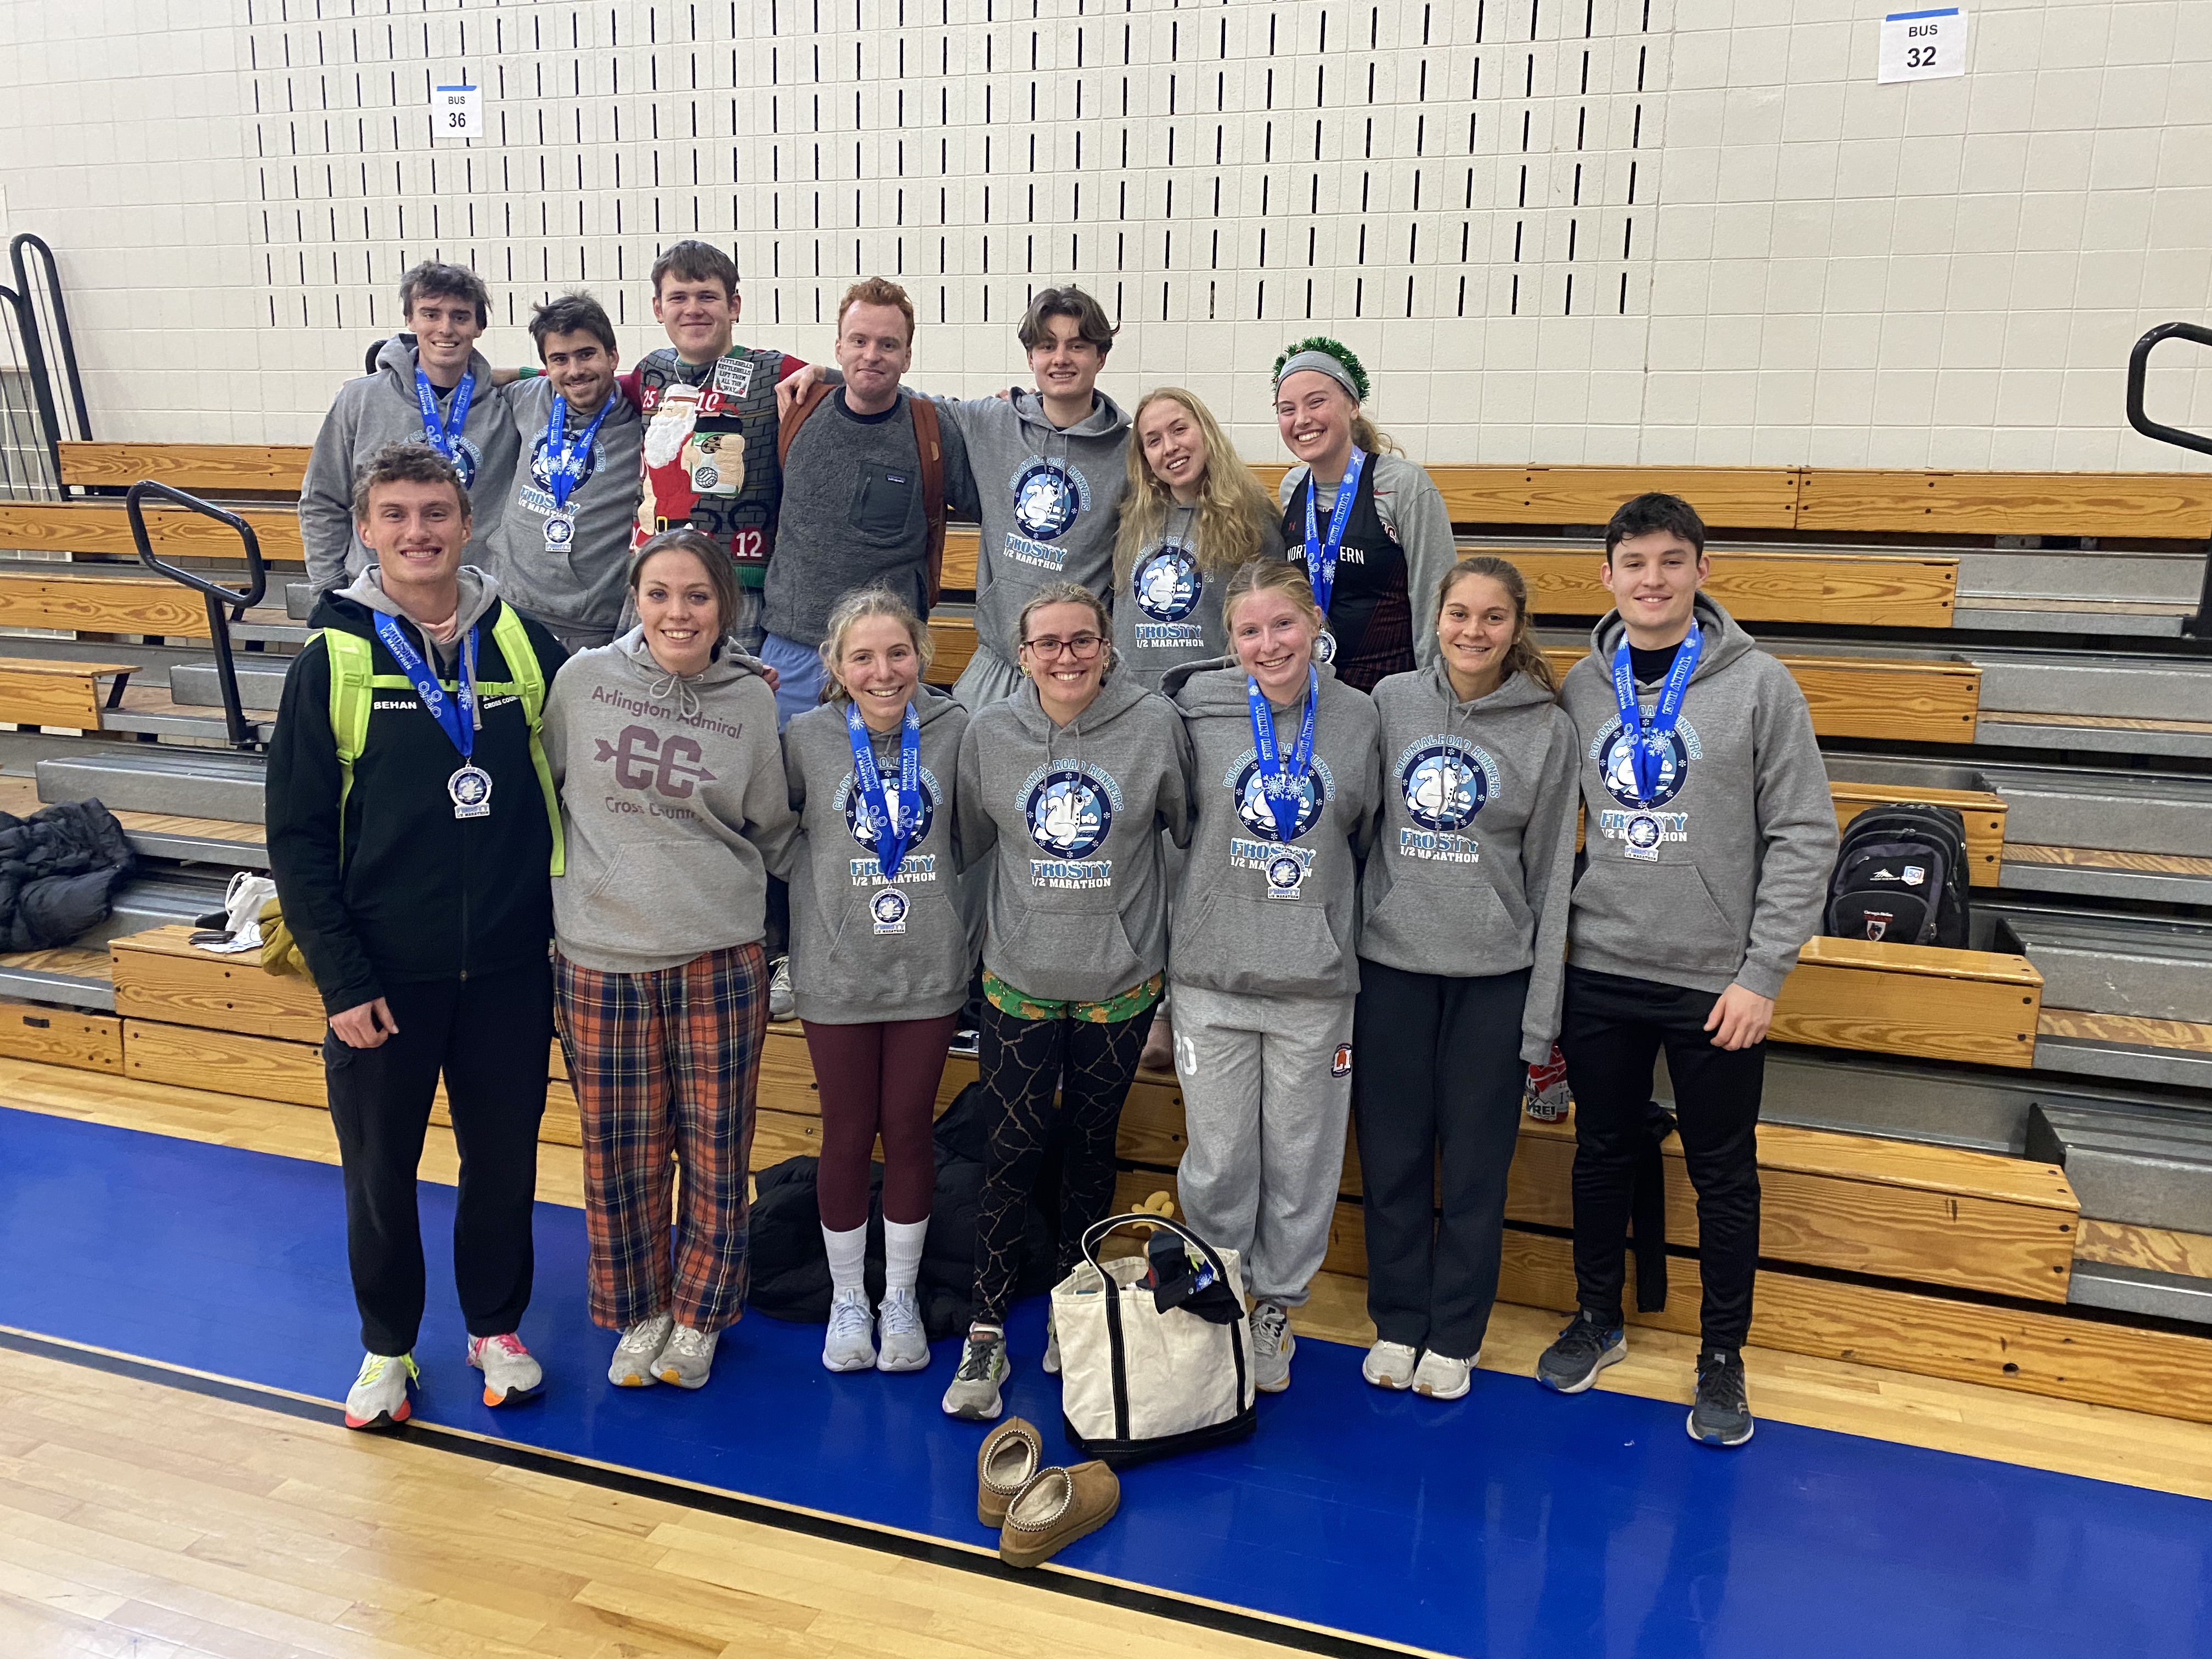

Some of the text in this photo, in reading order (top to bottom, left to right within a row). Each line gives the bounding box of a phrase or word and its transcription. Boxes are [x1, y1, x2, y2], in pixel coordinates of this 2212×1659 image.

[1909, 25, 1938, 37] BUS
[1907, 46, 1937, 67] 32
[448, 96, 465, 104] BUS
[449, 112, 466, 127] 36
[718, 364, 751, 375] KETTLEBELLS
[719, 359, 752, 369] KETTLEBELLS
[642, 390, 657, 409] 25
[696, 391, 720, 412] 10
[1008, 455, 1041, 490] COLONIAL
[1067, 465, 1091, 511] RUNNERS
[517, 497, 527, 507] 1/2
[520, 484, 581, 515] FROSY
[736, 531, 763, 557] 12
[1005, 532, 1068, 563] FROSTY
[1003, 548, 1063, 572] 1/2 MARATHON
[1135, 623, 1202, 639] FROSTY
[1136, 639, 1204, 648] 1/2 MARATHON
[386, 639, 413, 670] MARATHON
[1669, 655, 1692, 691] ANNUAL
[1616, 675, 1627, 710] MARATHON
[374, 701, 417, 710] BEHAN
[483, 699, 502, 709] CROSS
[591, 686, 743, 739] Arlington Admiral
[1589, 713, 1622, 759] COLONIA
[616, 725, 702, 799] CC
[1393, 735, 1437, 778] COLONIAL
[1471, 745, 1501, 799] RUNNERS
[857, 759, 871, 792] MARATHON
[1311, 752, 1335, 802] UNNERS
[1015, 763, 1053, 811] COLONIAL
[1087, 763, 1124, 812] RUNNERS
[605, 797, 644, 814] Cross
[1400, 827, 1479, 853] FROSTY
[1231, 856, 1245, 867] 1/2
[1400, 845, 1480, 863] 1/2 MARATHON
[1030, 859, 1112, 879] FROSTY
[852, 876, 868, 887] 1/2
[1031, 877, 1111, 889] 1/2 MARATHON
